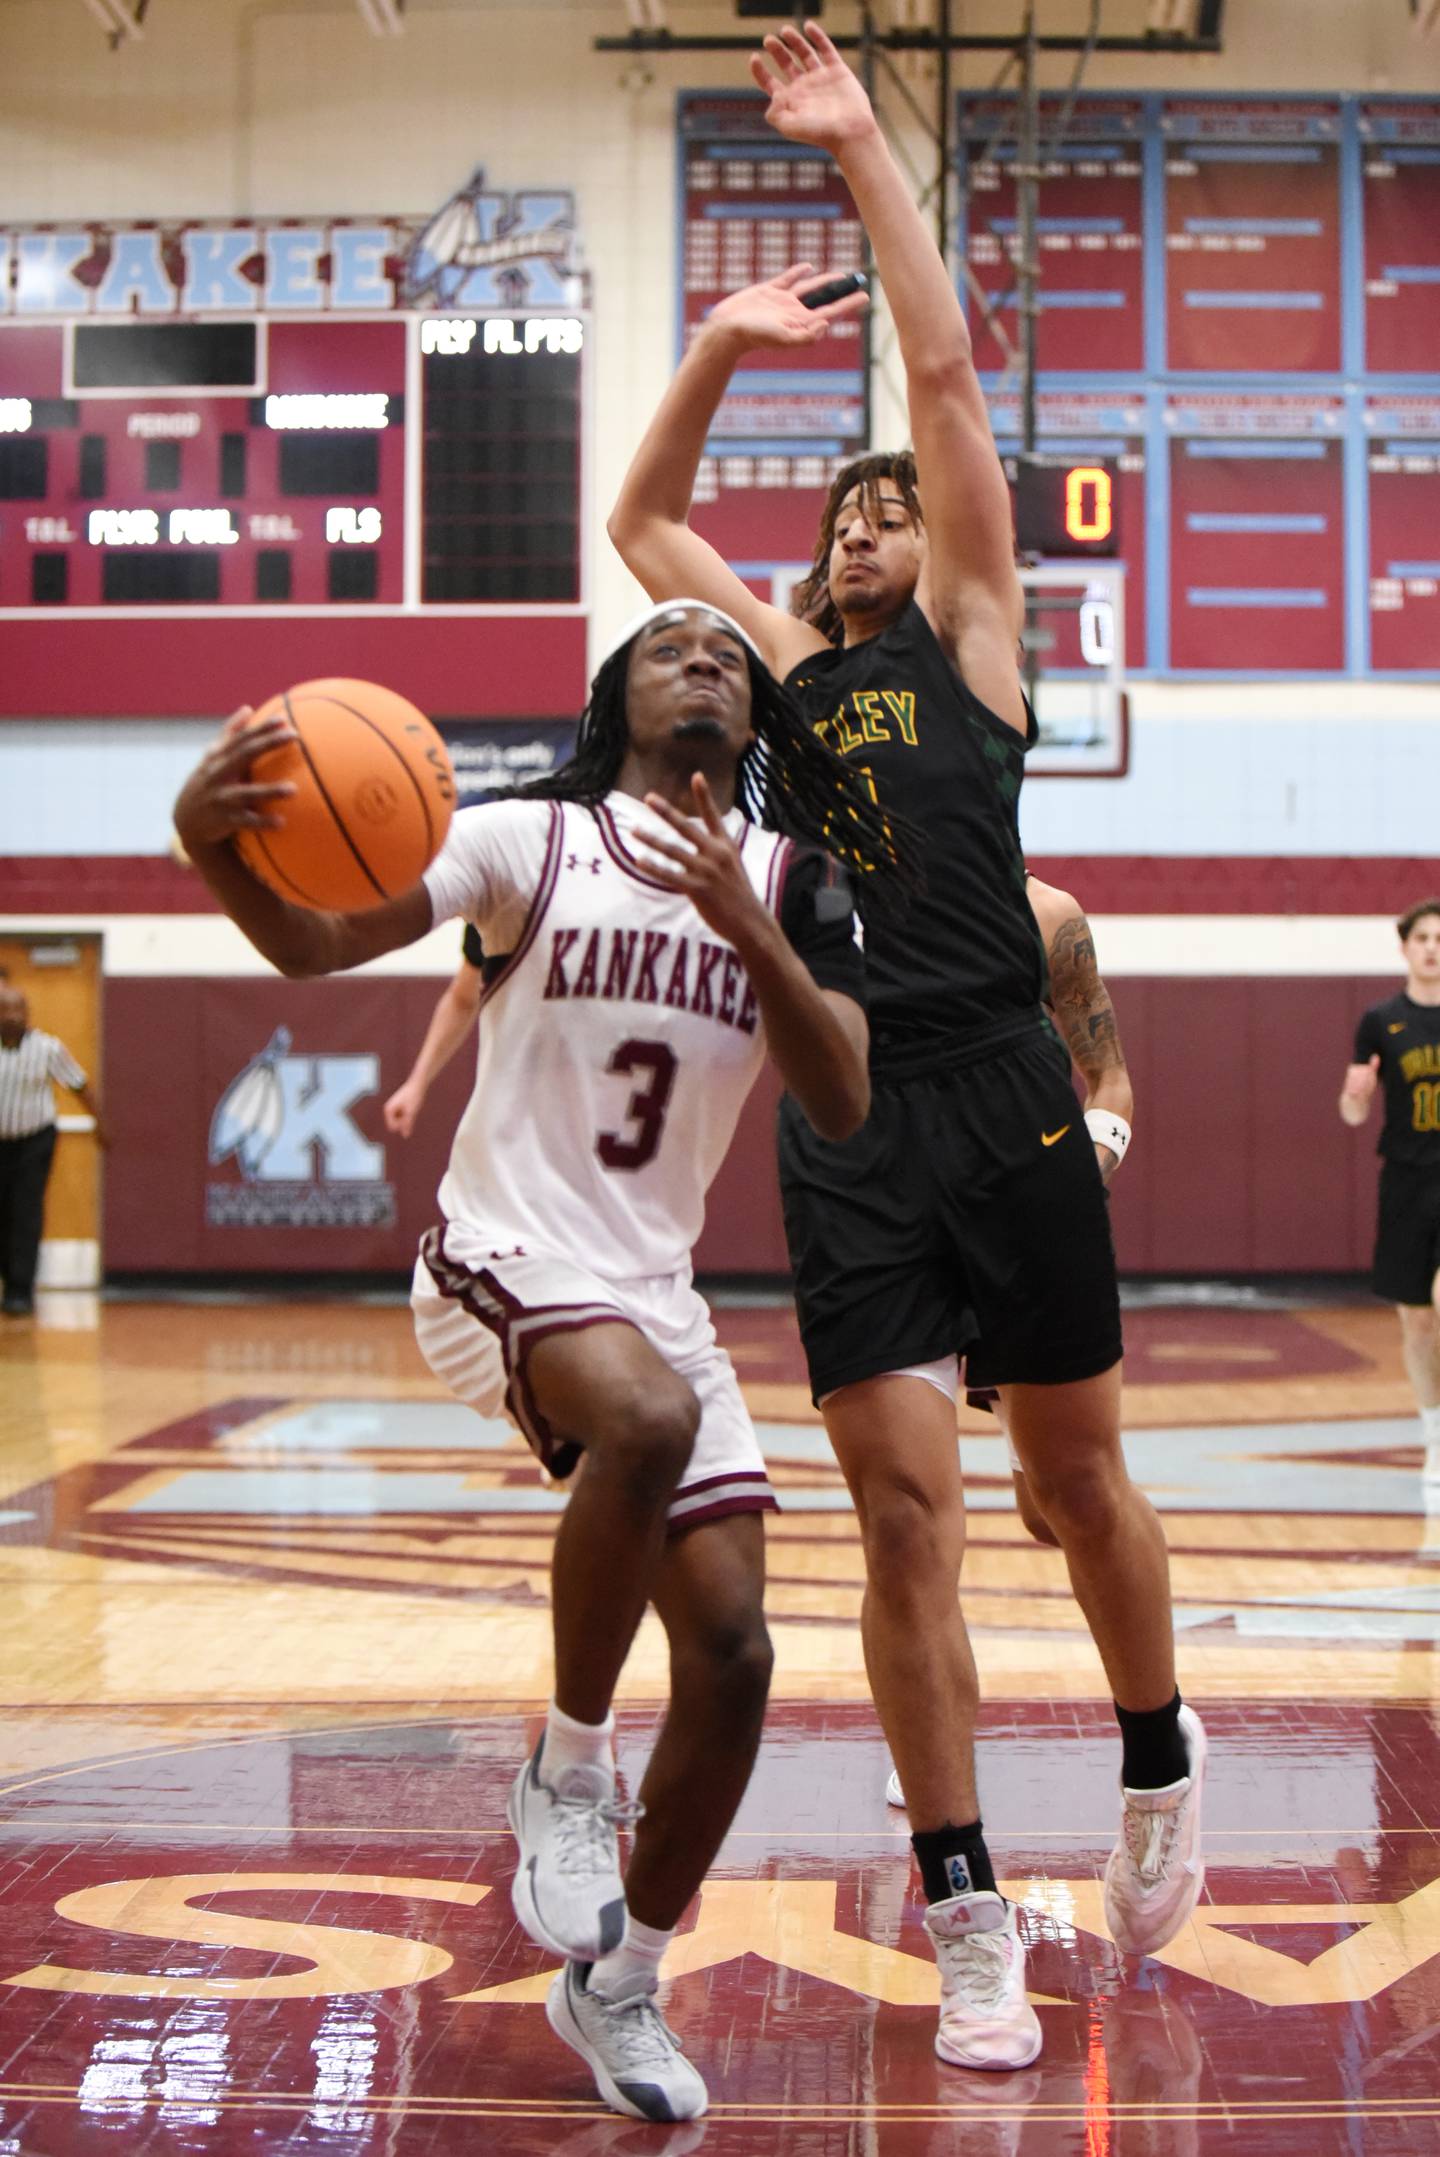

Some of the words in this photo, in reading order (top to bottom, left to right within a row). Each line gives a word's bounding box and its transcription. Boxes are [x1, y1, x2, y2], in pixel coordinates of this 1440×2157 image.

[1066, 467, 1112, 541] 0
[543, 926, 758, 1037] KANKAKEE
[250, 1052, 385, 1182] K
[594, 1038, 679, 1173] 3
